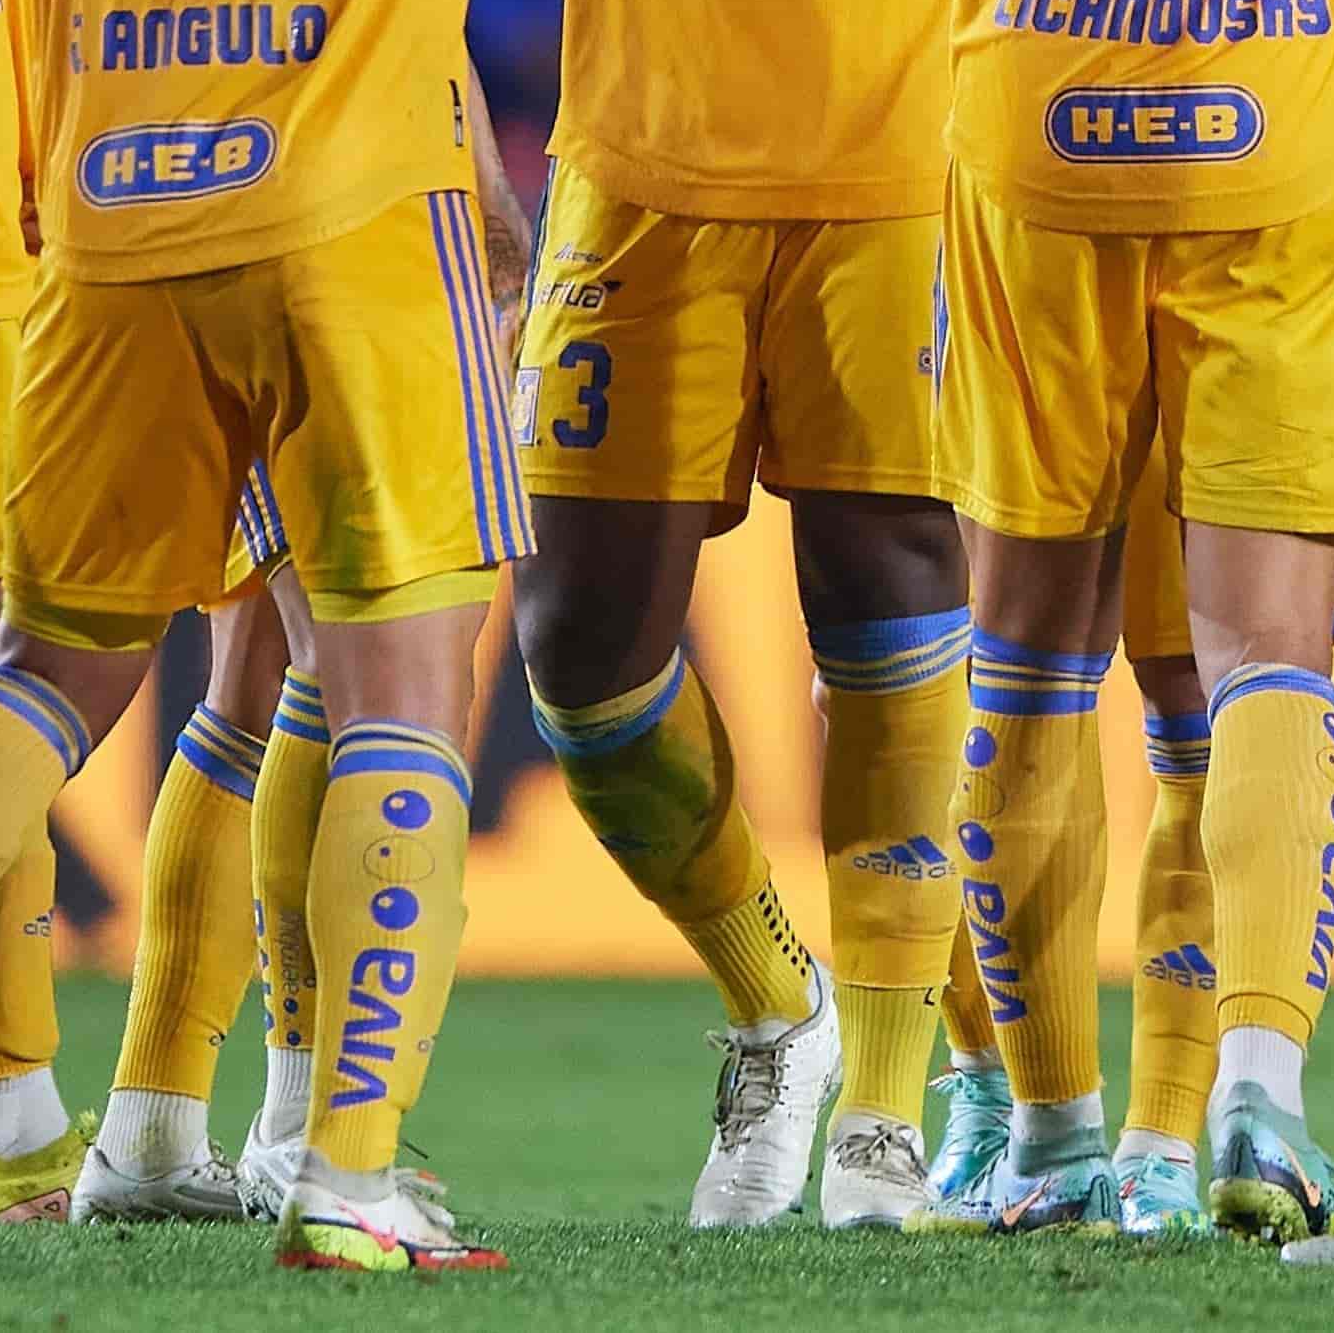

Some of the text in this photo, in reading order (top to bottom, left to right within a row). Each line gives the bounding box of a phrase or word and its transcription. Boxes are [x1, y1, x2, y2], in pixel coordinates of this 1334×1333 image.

[102, 3, 328, 71] ANGULO
[1070, 104, 1239, 144] H-E-B
[101, 134, 253, 188] H-E-B
[552, 340, 613, 449] 3
[961, 877, 1028, 1025] viva
[1143, 964, 1217, 990] adida
[330, 946, 416, 1110] viva
